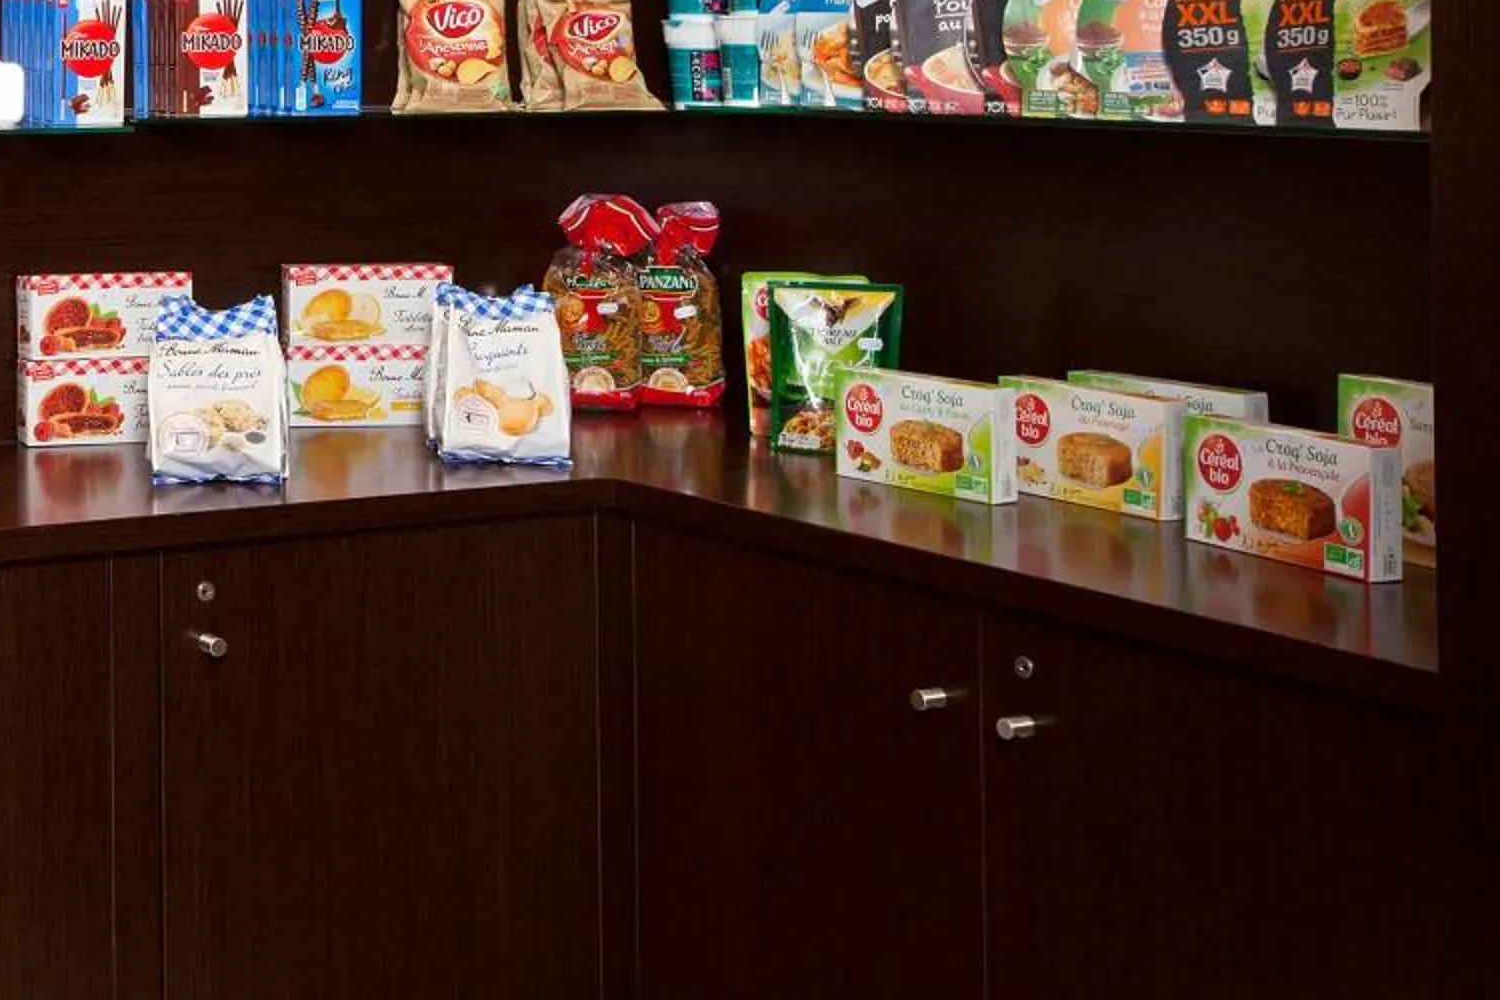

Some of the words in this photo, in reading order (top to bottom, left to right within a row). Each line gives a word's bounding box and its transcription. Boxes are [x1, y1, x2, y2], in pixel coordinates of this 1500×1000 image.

[433, 3, 483, 32] Vico
[938, 19, 961, 31] au
[1177, 2, 1238, 27] XXL
[1278, 1, 1331, 27] XXL
[573, 14, 618, 38] Vico
[1277, 26, 1316, 48] 350
[1317, 28, 1329, 46] g
[182, 30, 243, 53] MIKADO
[299, 31, 356, 53] MIKADO
[1177, 27, 1223, 49] 350
[1226, 29, 1239, 46] g
[61, 40, 121, 60] MIKADO
[901, 384, 935, 404] Croq'
[938, 389, 965, 407] Soja
[1071, 395, 1105, 415] Croq'
[1107, 402, 1136, 419] Soja
[854, 411, 873, 428] bio
[1354, 411, 1399, 434] Céréal
[1020, 423, 1040, 440] bio
[1200, 450, 1239, 472] Céréal
[1265, 438, 1304, 459] Croq'
[1307, 444, 1338, 466] Soja
[1208, 468, 1229, 485] bio
